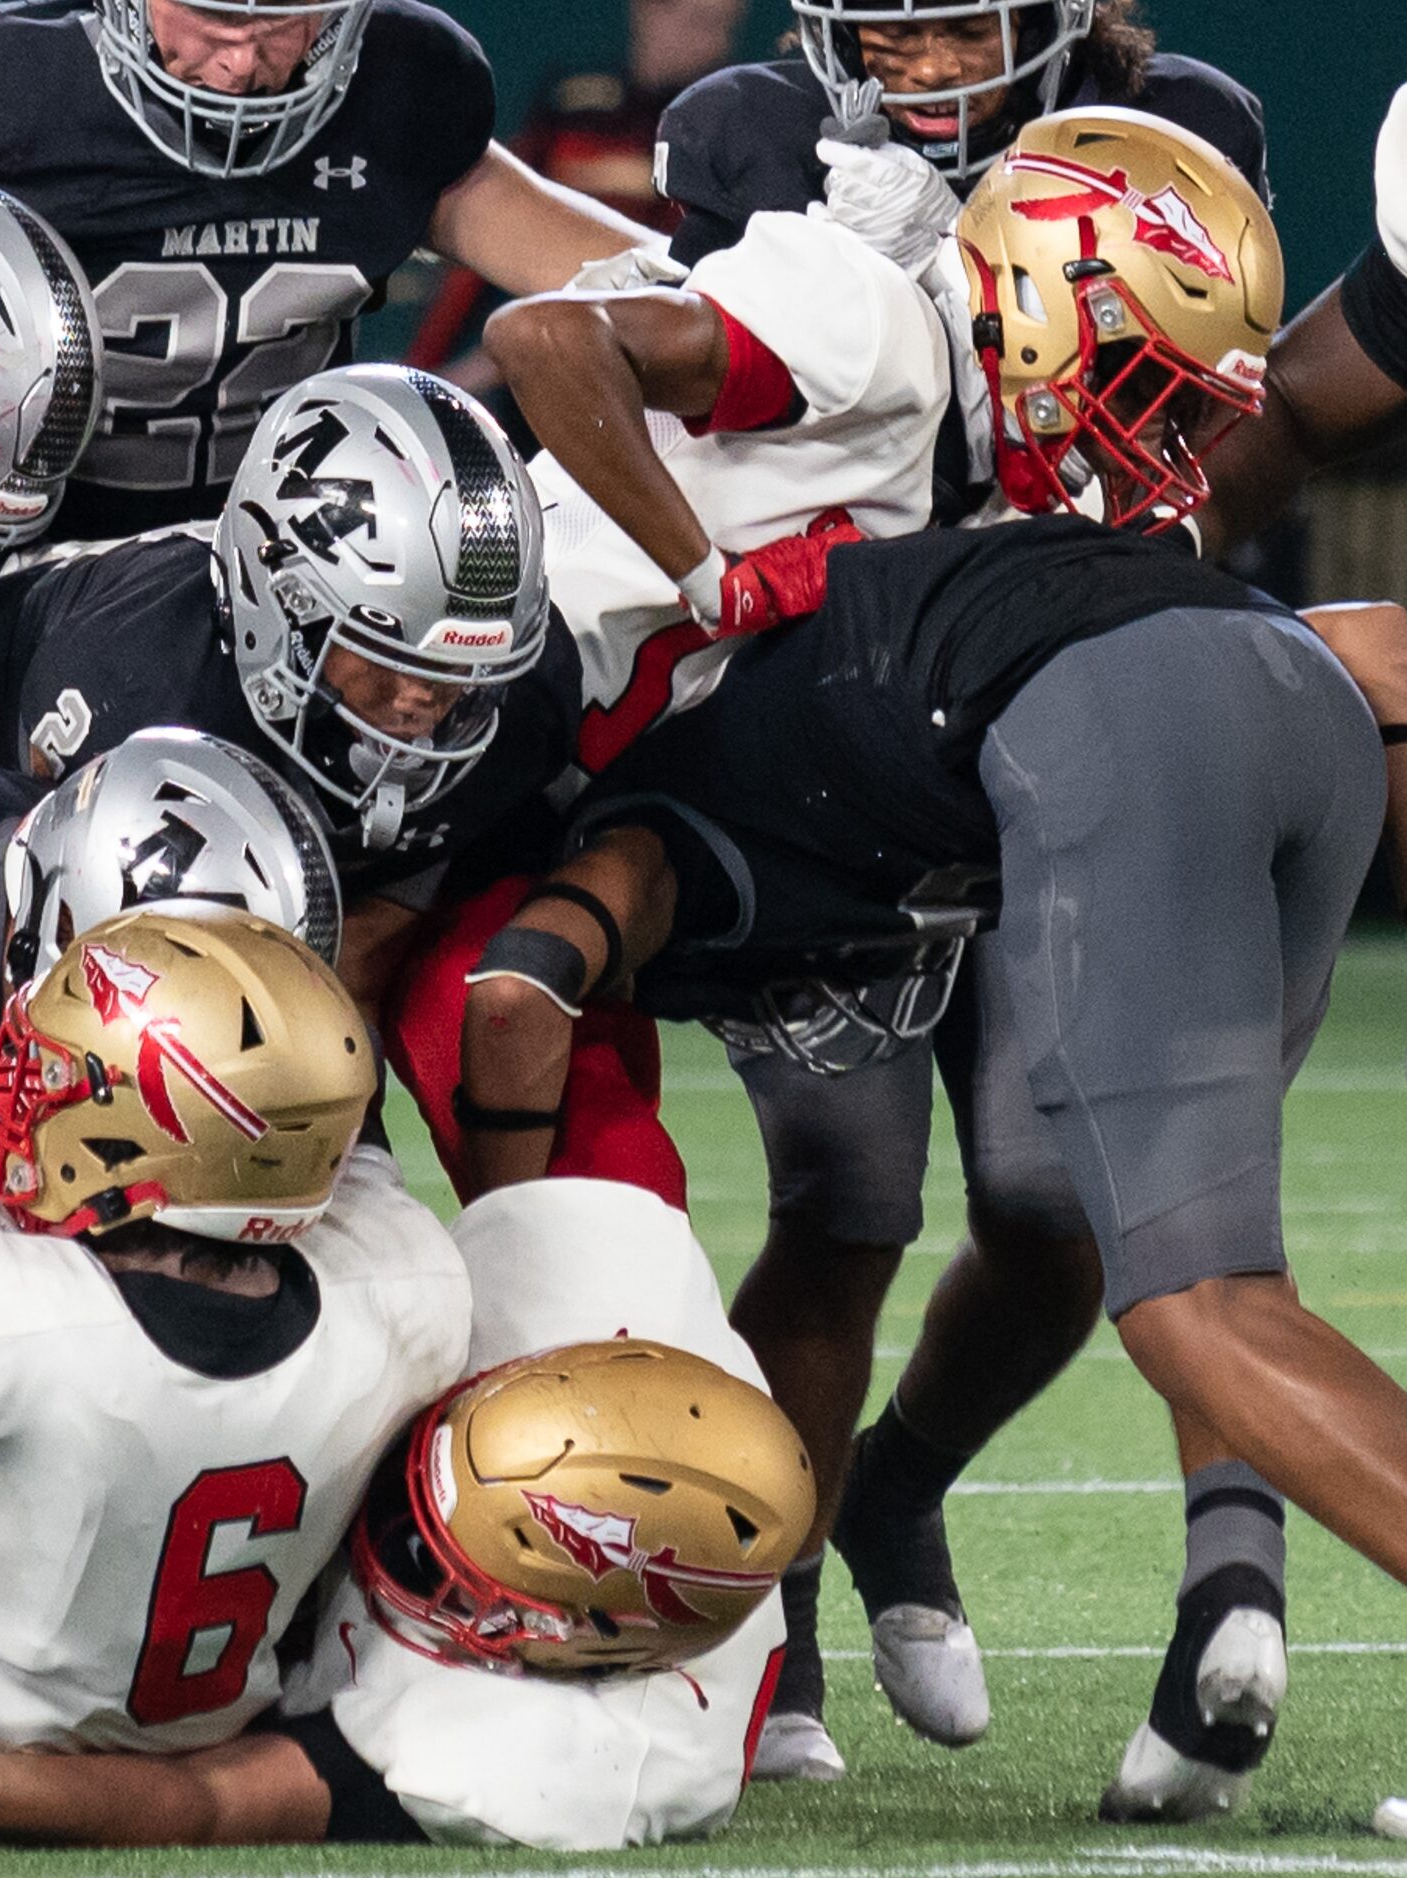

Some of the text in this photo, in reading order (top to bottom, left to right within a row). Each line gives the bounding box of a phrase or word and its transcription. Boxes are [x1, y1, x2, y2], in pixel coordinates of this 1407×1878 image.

[161, 217, 320, 257] MARTIN
[75, 262, 374, 491] 22
[126, 1456, 308, 1728] 6
